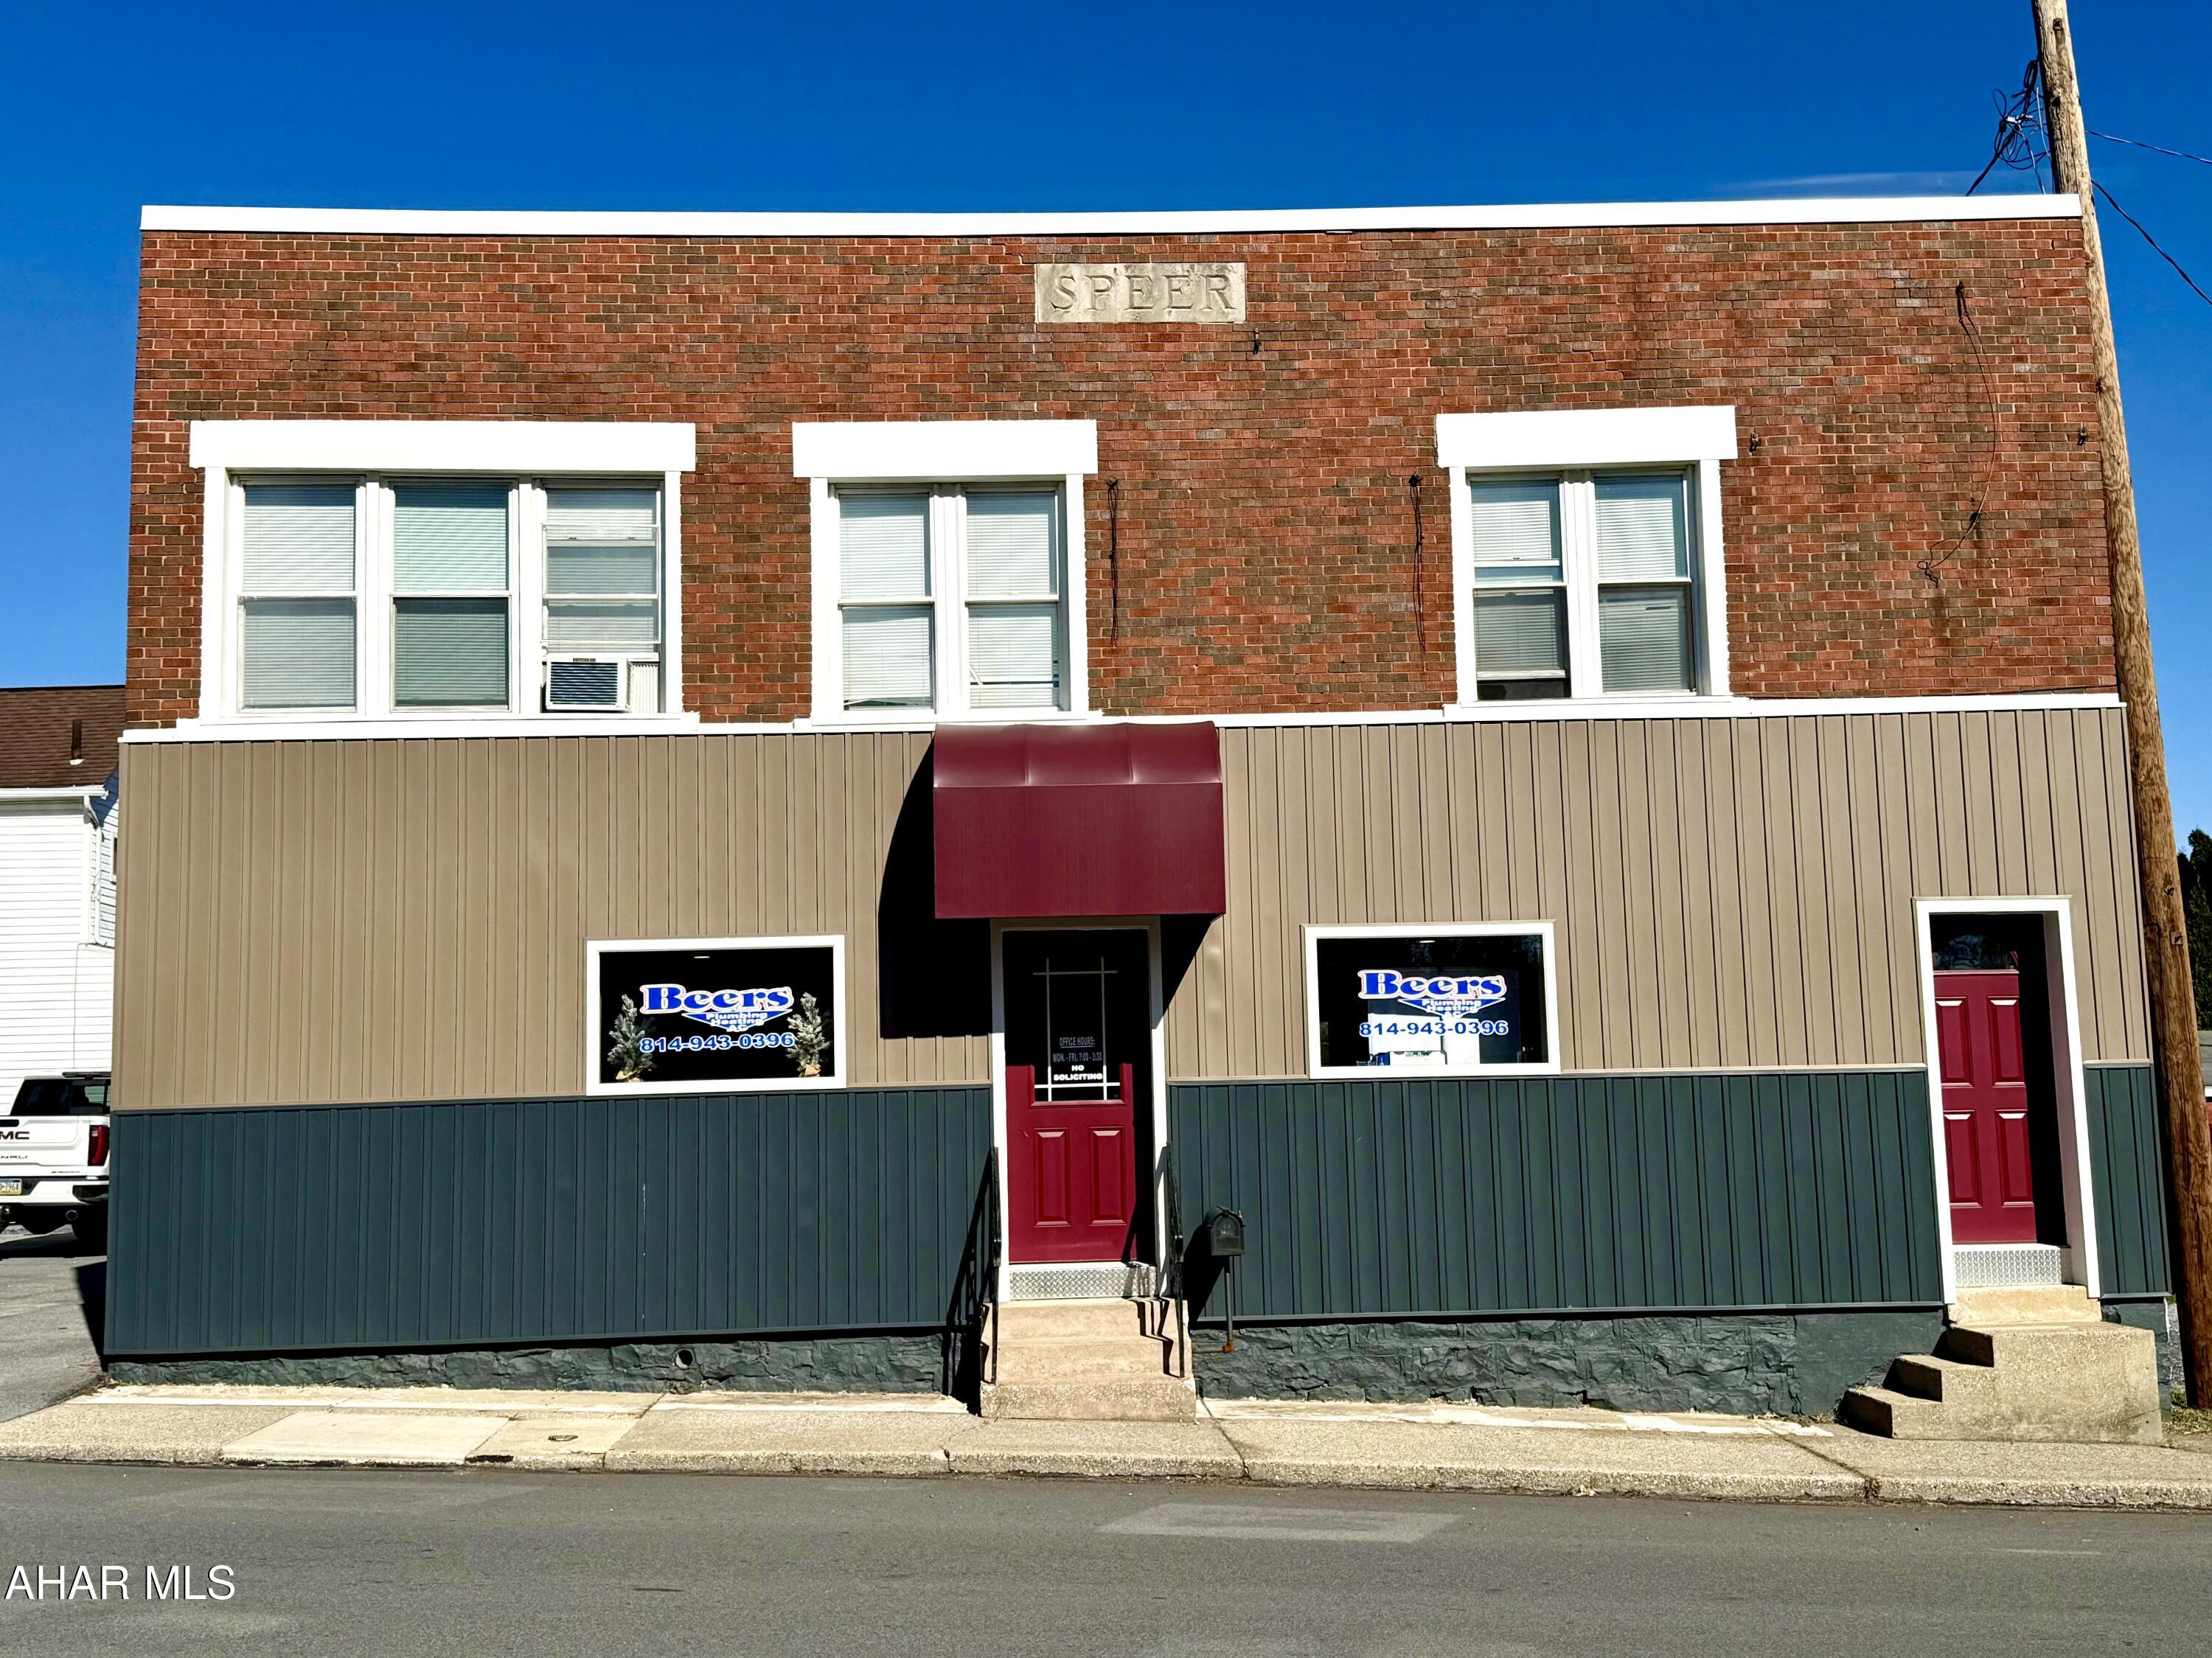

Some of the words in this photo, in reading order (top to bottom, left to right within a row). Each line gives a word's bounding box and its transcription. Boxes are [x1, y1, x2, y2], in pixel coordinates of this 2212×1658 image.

[1051, 274, 1239, 311] SPEER
[1358, 970, 1507, 998] Beers
[640, 984, 794, 1014] Beers
[1427, 1005, 1478, 1013] Heating
[711, 1018, 764, 1026] Heating
[726, 1024, 748, 1032] AC
[1360, 1020, 1509, 1036] 814-943-0396
[640, 1033, 795, 1053] 814-943-0396
[1060, 1037, 1076, 1045] OFFICE
[1077, 1037, 1095, 1045] HOURS:
[1054, 1073, 1103, 1081] SOLICITING
